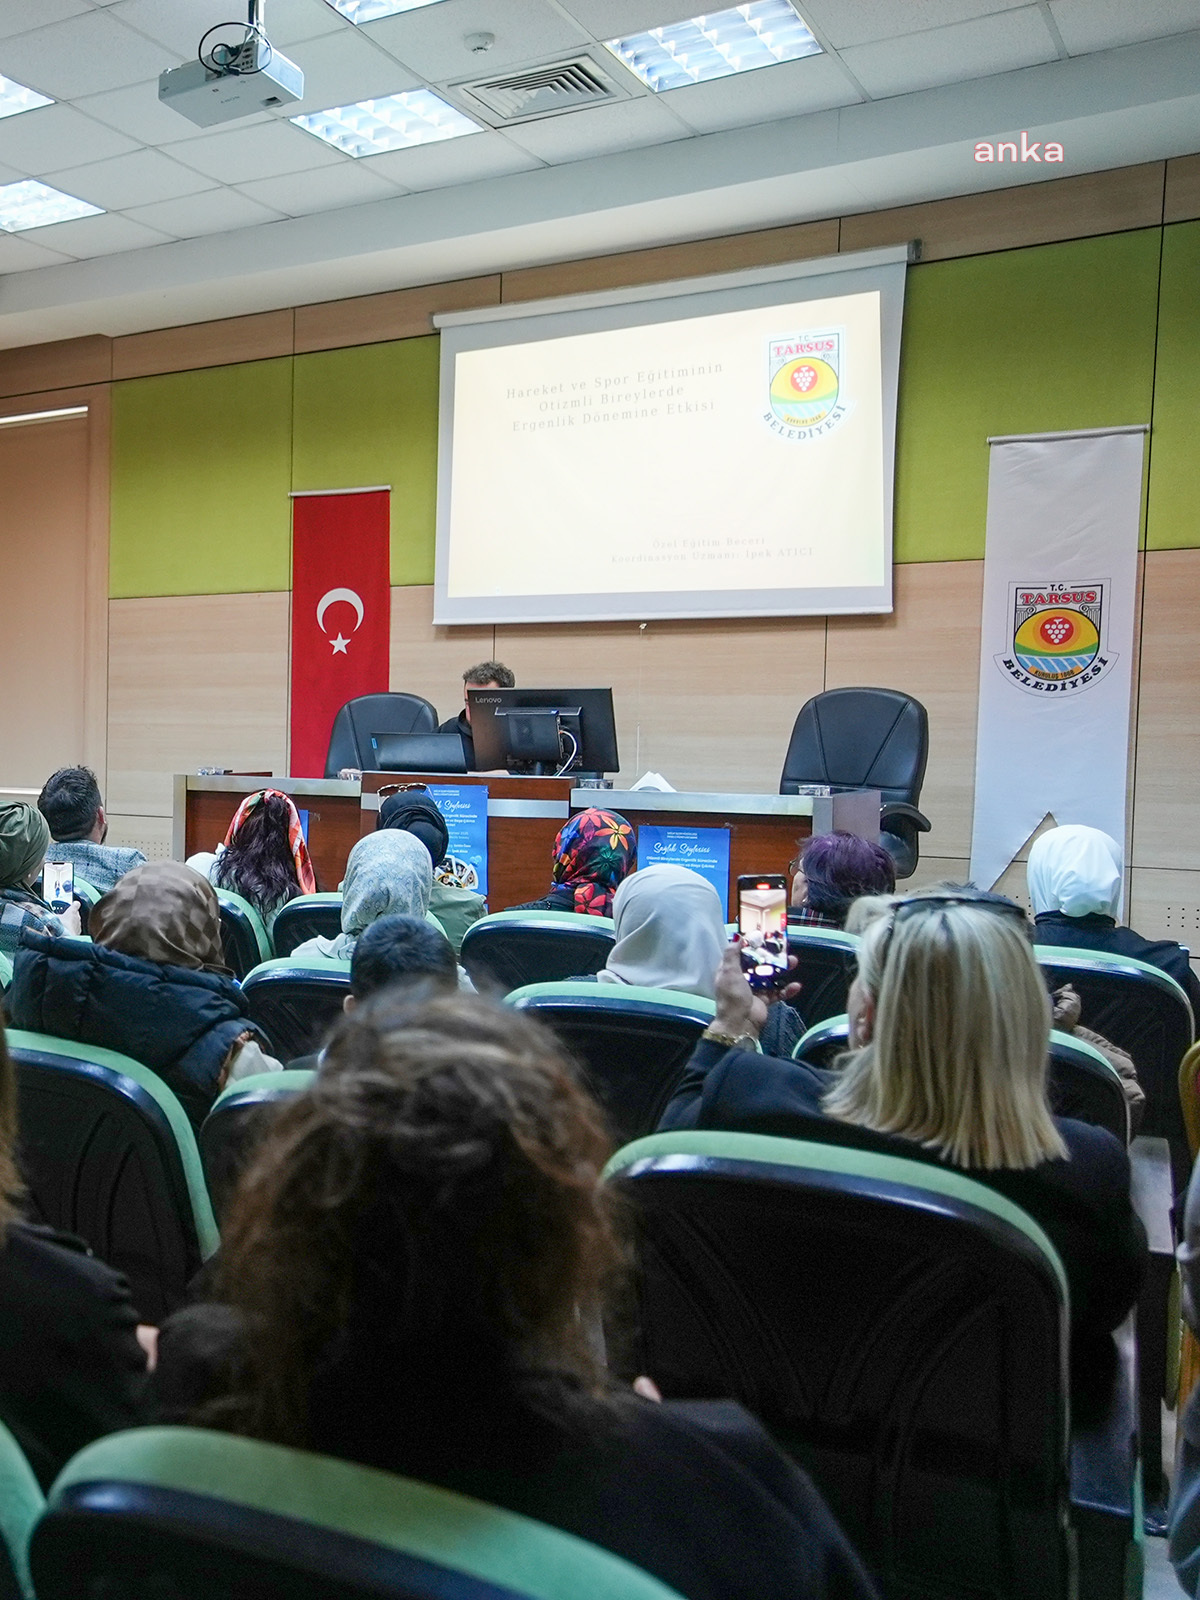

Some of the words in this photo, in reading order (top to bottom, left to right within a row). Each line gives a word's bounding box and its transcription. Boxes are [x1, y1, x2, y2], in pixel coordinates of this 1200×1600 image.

[774, 340, 835, 356] TARSUS
[506, 383, 564, 400] Hareket
[571, 380, 587, 392] ve
[594, 375, 630, 390] Spor
[636, 362, 723, 383] Eğitiminin
[539, 395, 593, 412] Otizmli
[601, 385, 685, 405] Bireylerde
[512, 415, 576, 433] Ergenlik
[583, 405, 659, 425] Dönemine
[667, 399, 715, 415] Etkisi
[1020, 591, 1097, 605] TARSUS
[1003, 656, 1108, 692] BELEDİYESİ
